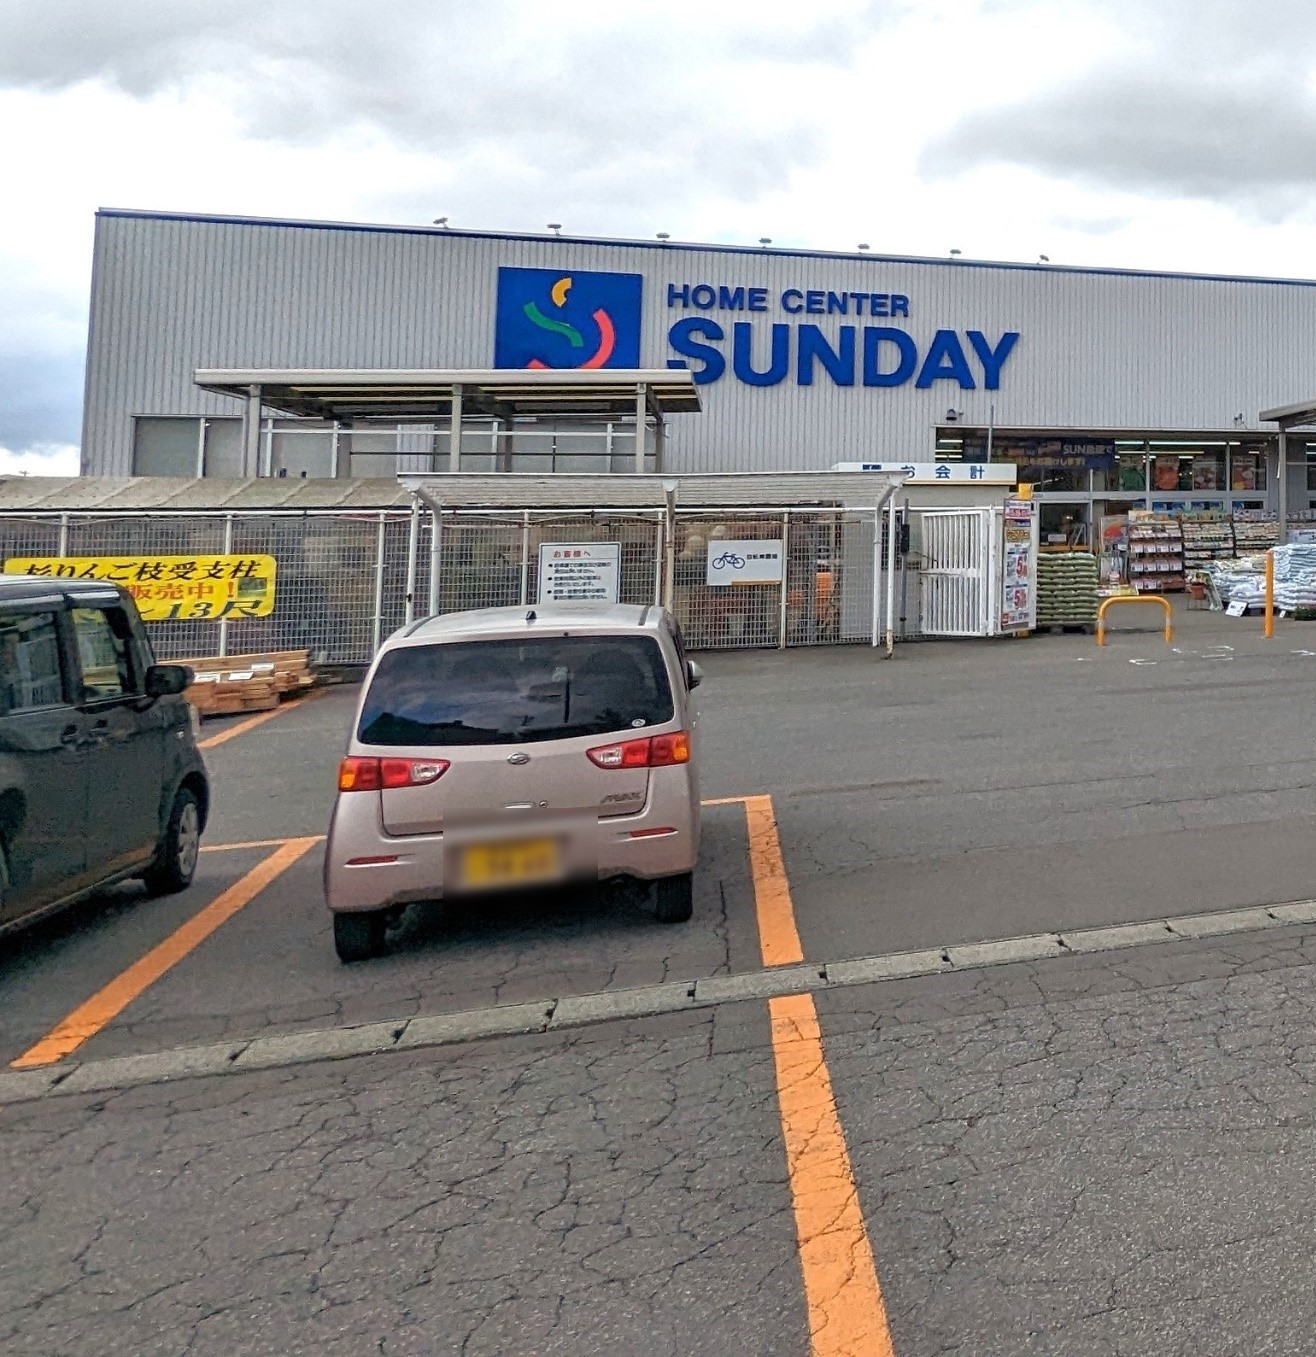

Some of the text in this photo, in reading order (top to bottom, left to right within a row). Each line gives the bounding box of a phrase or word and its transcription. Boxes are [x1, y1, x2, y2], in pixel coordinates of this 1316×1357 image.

[667, 282, 910, 318] HOME CENTER
[666, 316, 1020, 390] SUNDAY
